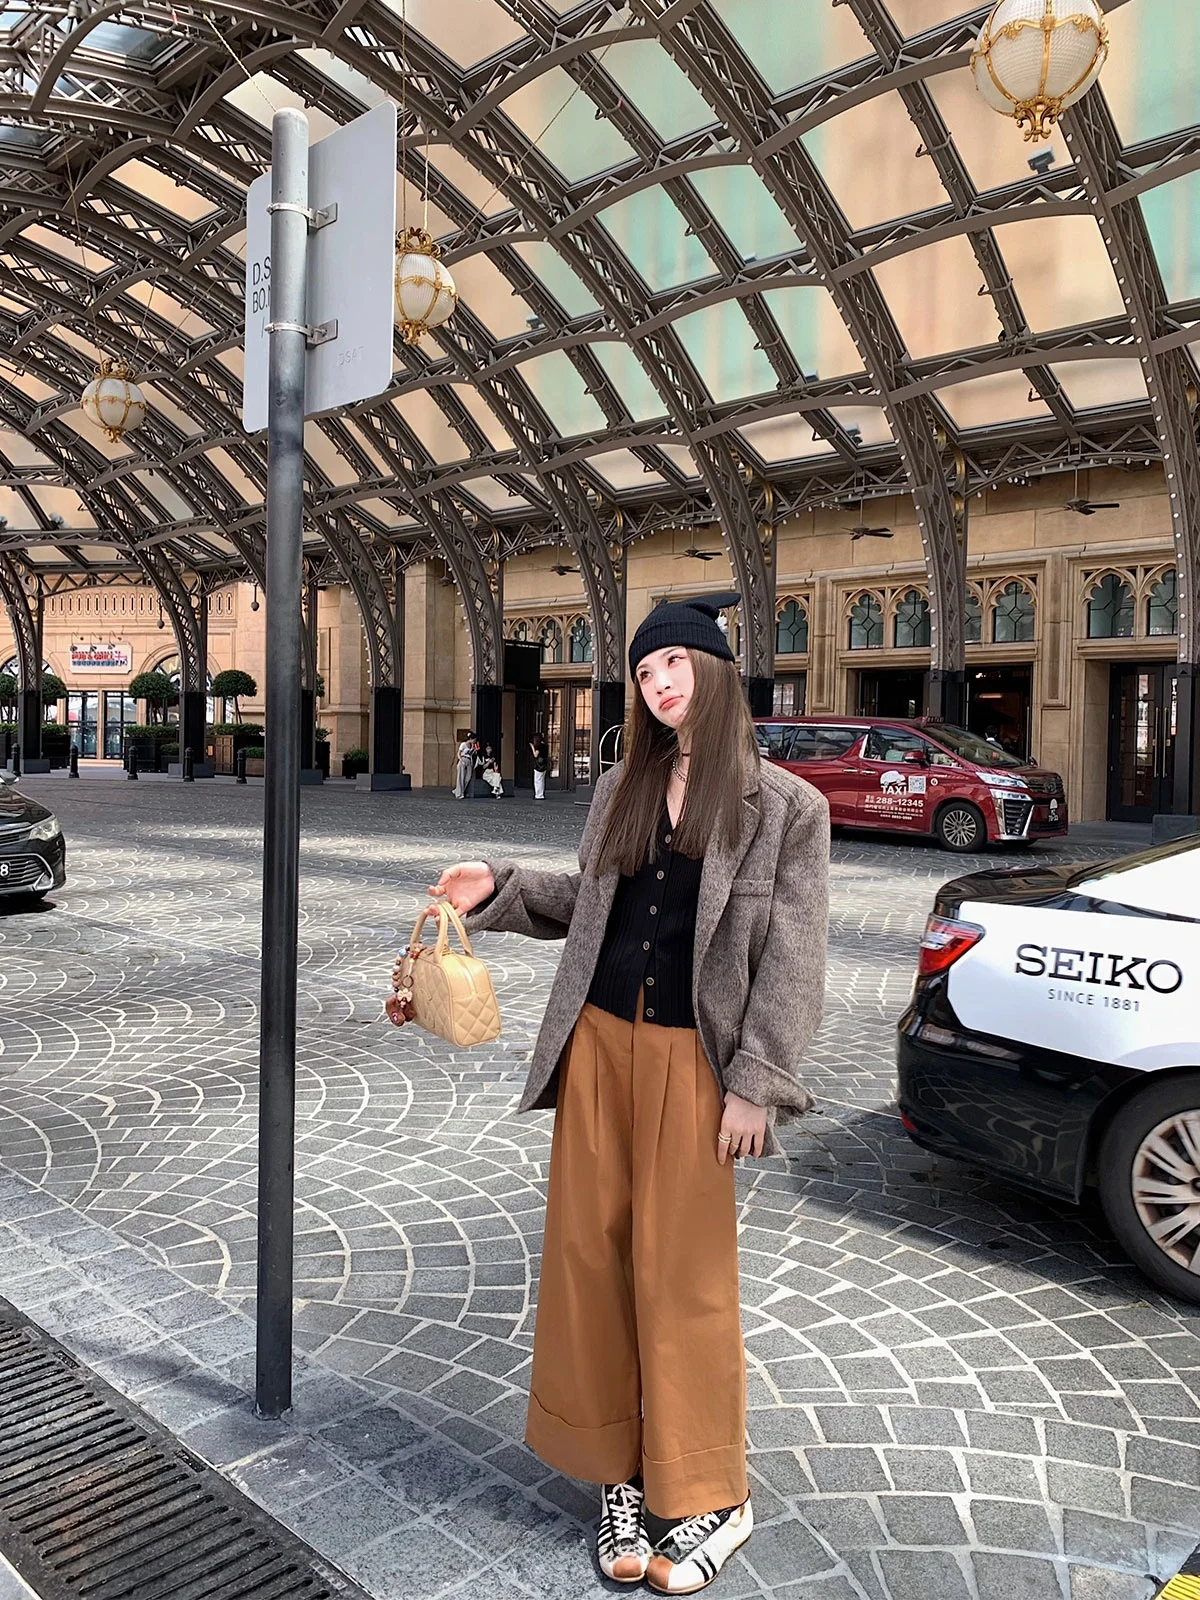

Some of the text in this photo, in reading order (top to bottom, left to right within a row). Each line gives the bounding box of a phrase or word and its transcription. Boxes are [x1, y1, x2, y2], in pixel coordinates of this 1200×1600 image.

[881, 785, 907, 796] TAXI
[876, 796, 924, 807] 288-12345
[0, 864, 9, 877] 8
[1015, 943, 1183, 994] SEIKO
[1048, 988, 1140, 1012] SINCE 1881
